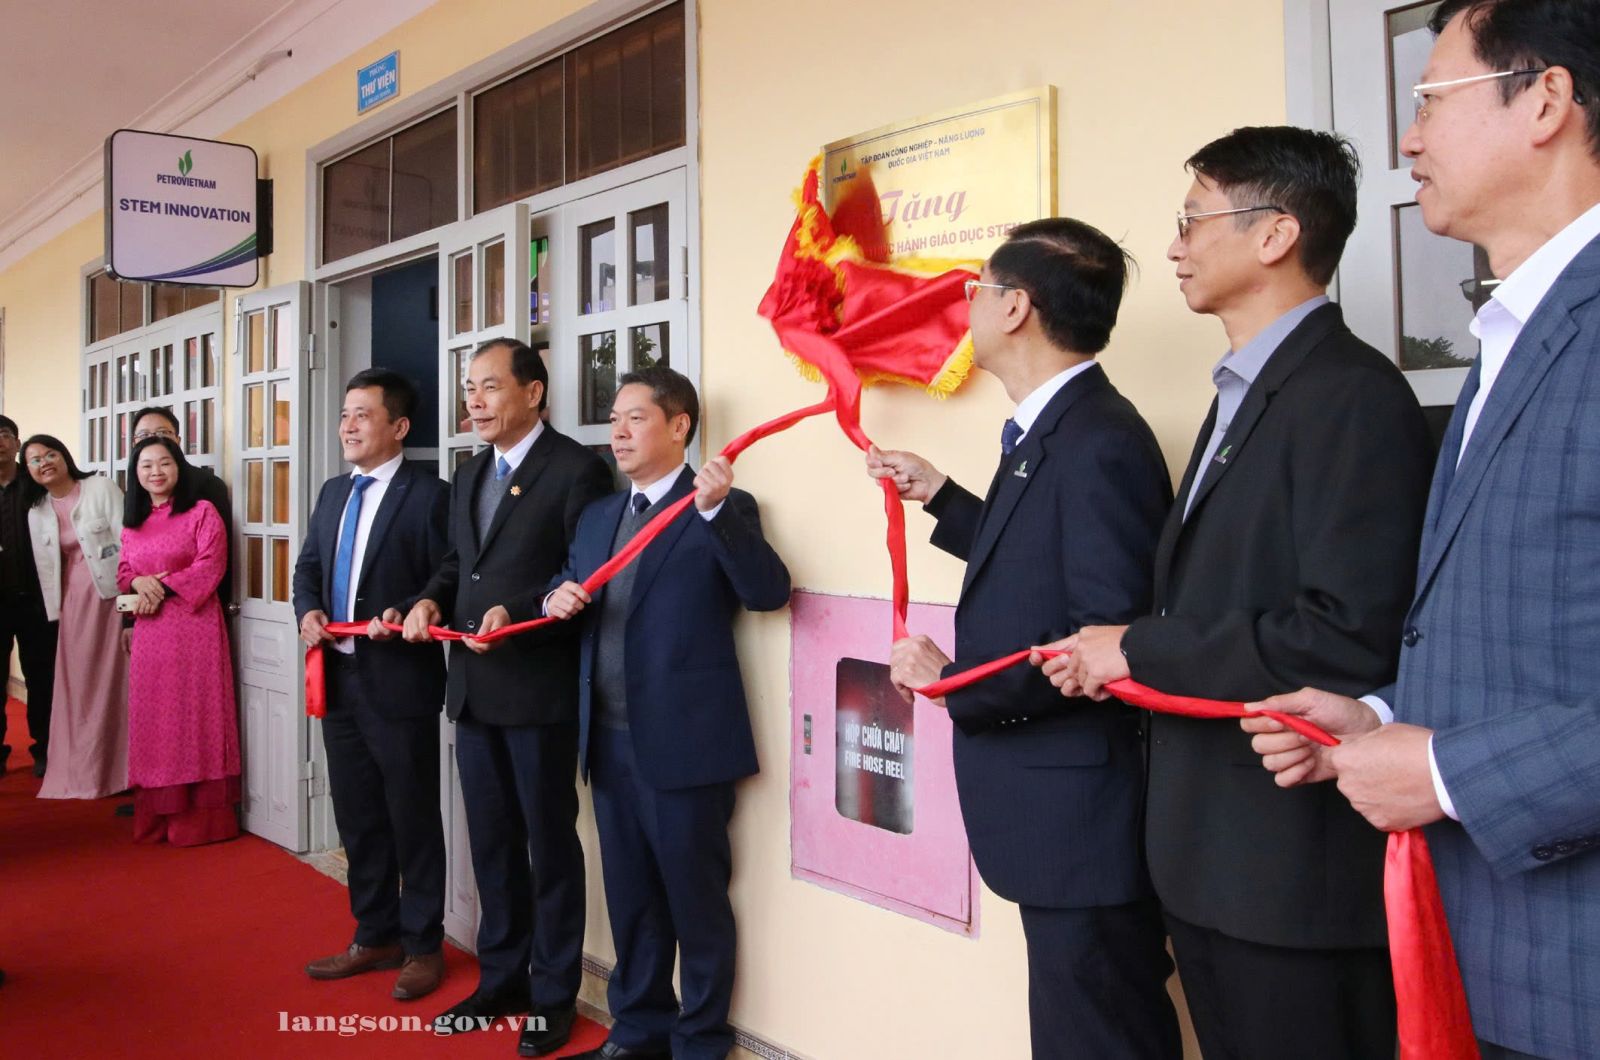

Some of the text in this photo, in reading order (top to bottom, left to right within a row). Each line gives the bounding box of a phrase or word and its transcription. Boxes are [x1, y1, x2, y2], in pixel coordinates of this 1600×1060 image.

[361, 78, 377, 98] THƯ
[377, 69, 396, 89] VIỆN
[888, 147, 950, 169] QUỐC GIA VIỆT NAM
[891, 145, 908, 157] CÔNG
[909, 139, 932, 152] NGHIỆP
[157, 174, 216, 189] PETROVIETNAM
[119, 198, 251, 223] STEM INNOVATION
[880, 190, 969, 229] Tặng
[897, 235, 927, 254] HÀNH
[929, 230, 956, 247] GIÁO
[960, 227, 984, 244] DỤC
[862, 722, 882, 750] CHỮA
[844, 750, 905, 779] FIRE HOSE REEL
